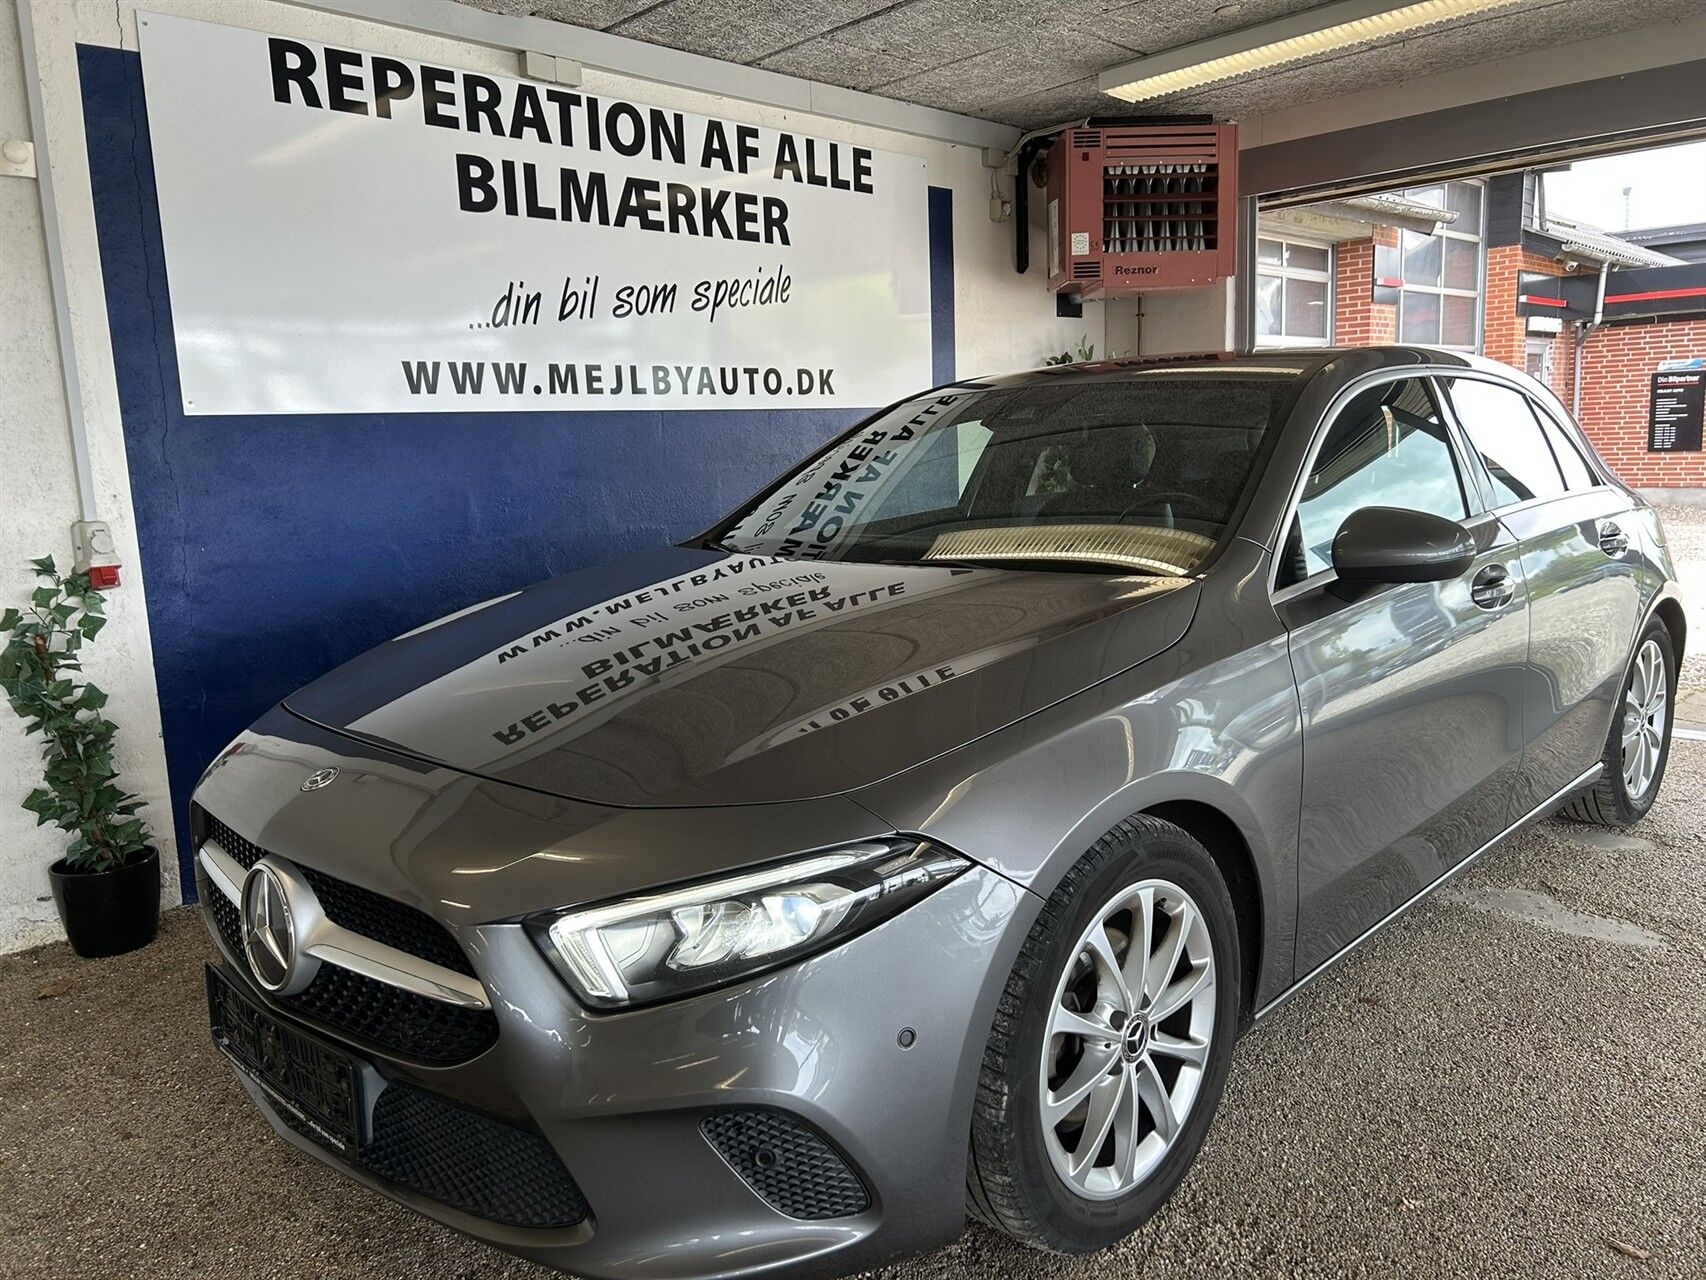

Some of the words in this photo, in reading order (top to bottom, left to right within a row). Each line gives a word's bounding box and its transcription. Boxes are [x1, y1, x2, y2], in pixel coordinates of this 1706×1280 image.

[267, 37, 686, 165] REPERATION
[700, 119, 760, 175] AF
[773, 133, 874, 194] ALLE
[455, 153, 791, 246] BILMÆRKER
[558, 276, 599, 322] bil
[612, 282, 678, 318] som
[690, 264, 791, 323] speciale
[1114, 265, 1158, 276] Reznor
[401, 360, 835, 396] WWW.MEJLBYAUTO.DK
